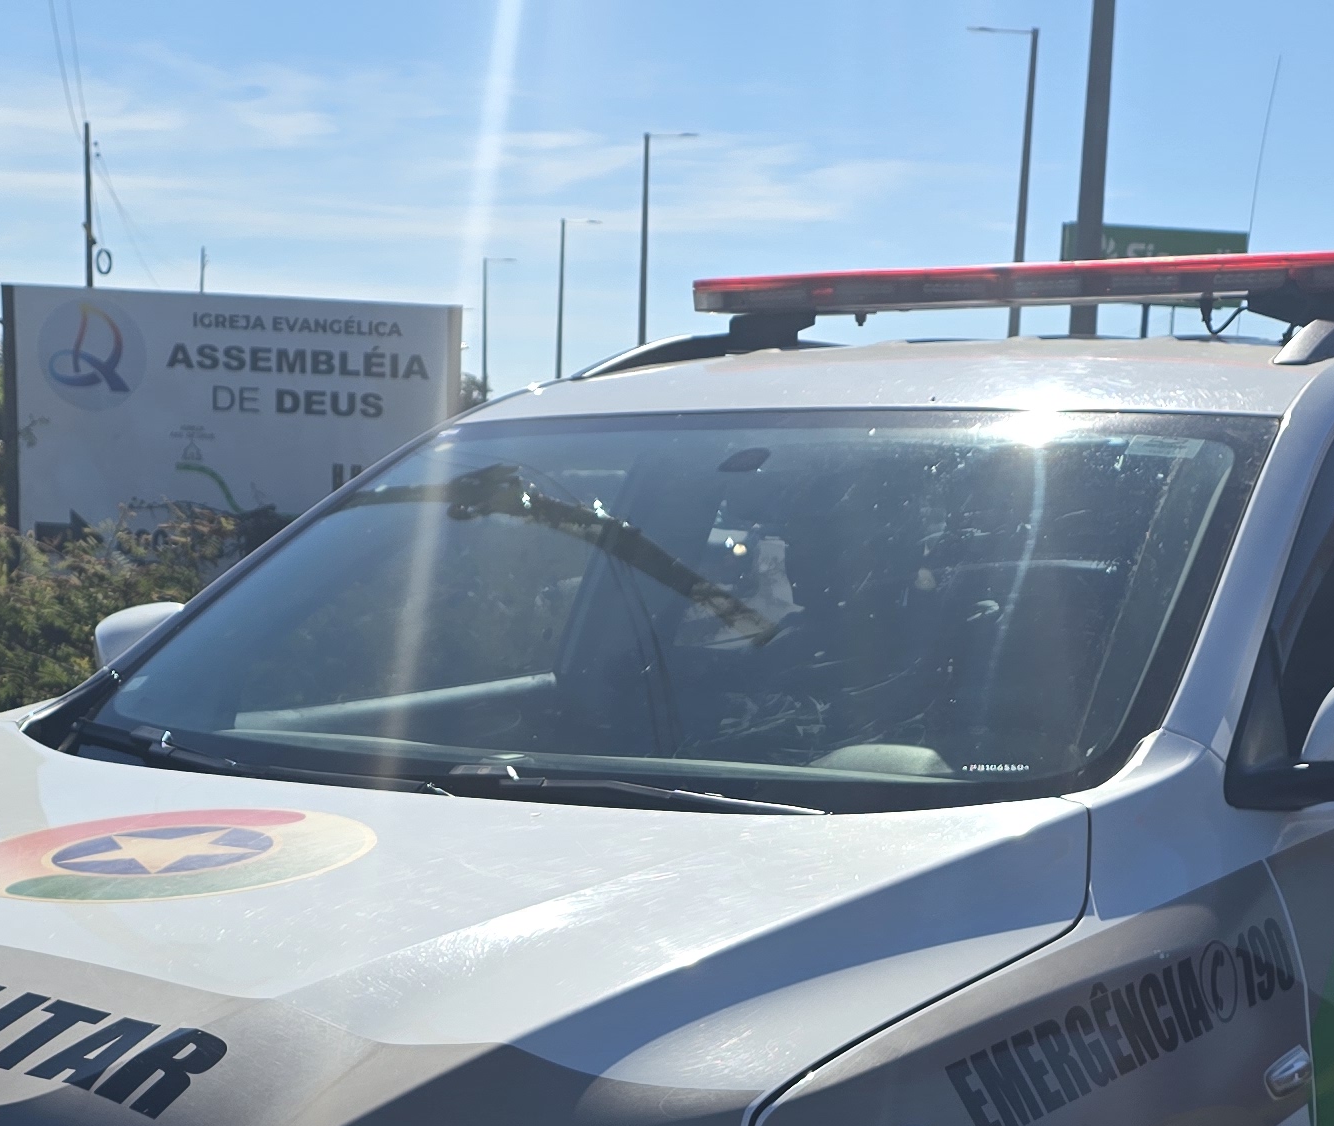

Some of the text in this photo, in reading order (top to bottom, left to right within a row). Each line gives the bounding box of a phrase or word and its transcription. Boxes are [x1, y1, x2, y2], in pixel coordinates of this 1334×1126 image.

[192, 311, 404, 338] IGREJA EVANGÉLICA
[167, 341, 430, 380] ASSEMBLÉIA
[211, 385, 385, 419] DE DEUS
[1235, 917, 1296, 1008] 190
